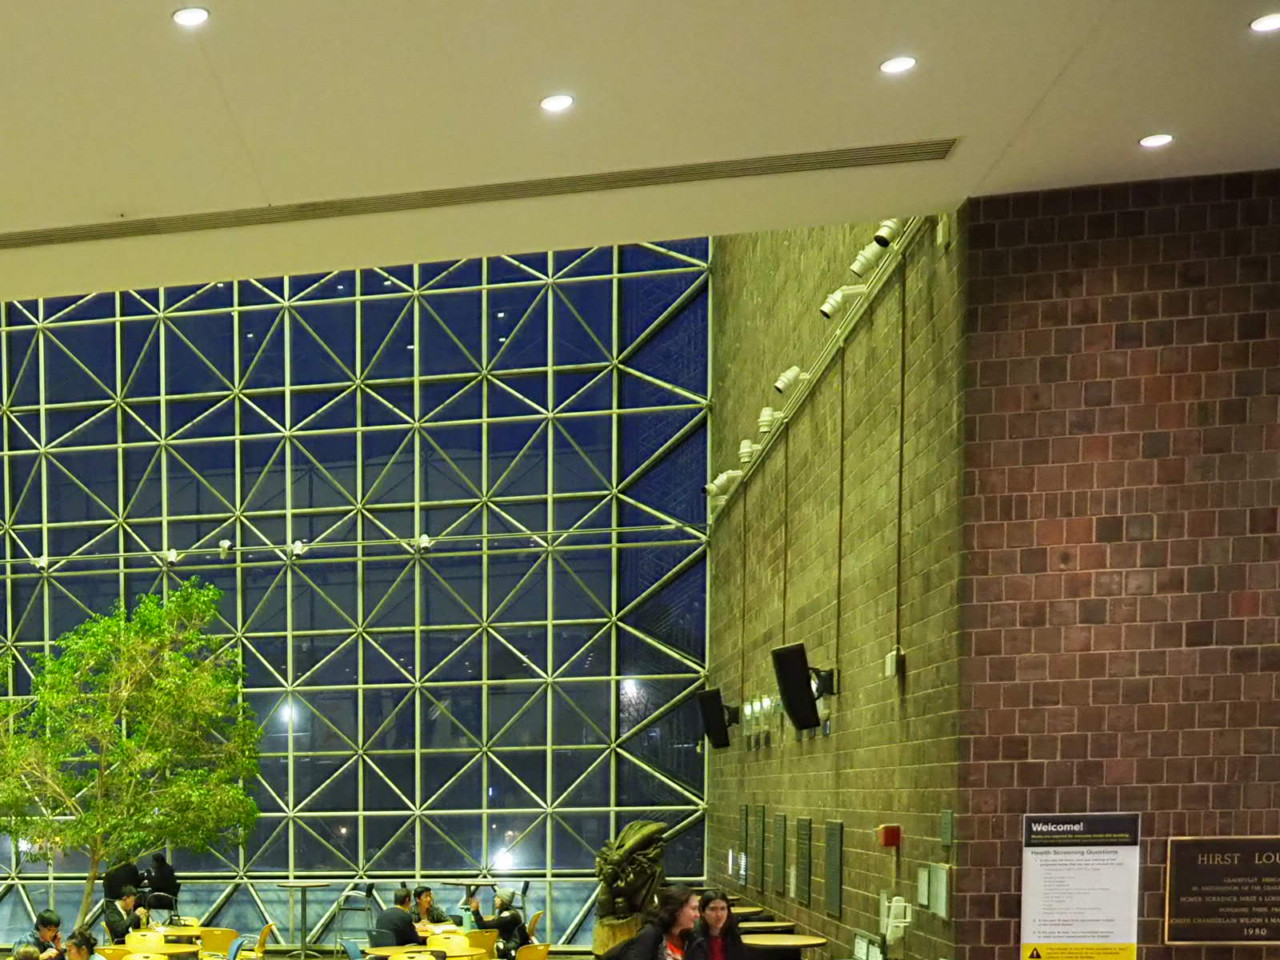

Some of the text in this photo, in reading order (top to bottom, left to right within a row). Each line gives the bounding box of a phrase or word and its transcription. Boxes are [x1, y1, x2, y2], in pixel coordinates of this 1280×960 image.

[1031, 822, 1083, 831] Welcome!
[1198, 853, 1240, 864] HIRST
[1244, 927, 1267, 935] 1980
